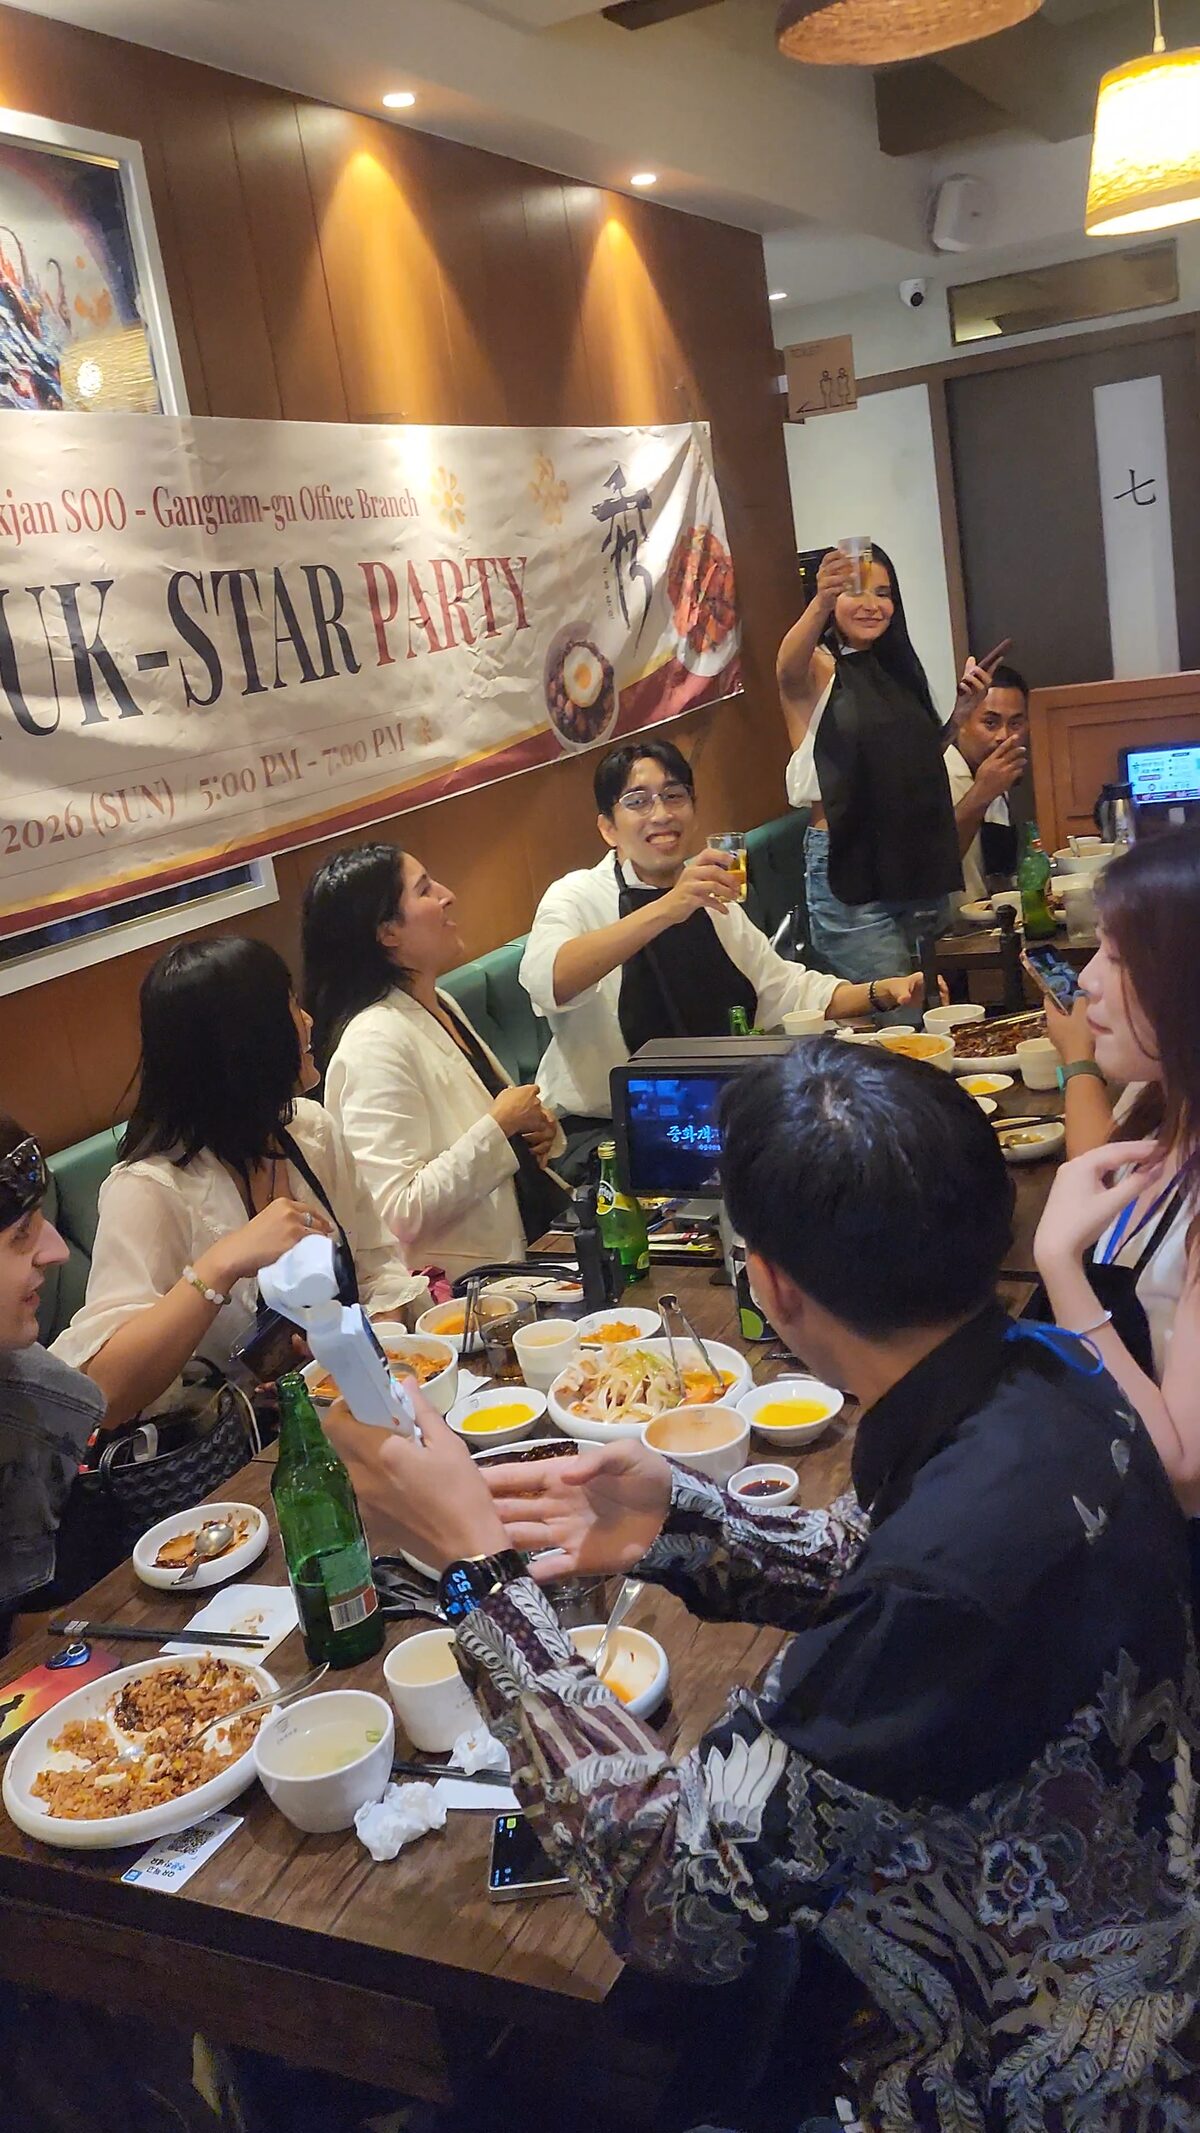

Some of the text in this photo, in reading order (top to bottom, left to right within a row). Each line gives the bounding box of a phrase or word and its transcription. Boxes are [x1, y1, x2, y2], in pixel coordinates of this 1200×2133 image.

[61, 487, 127, 533] SOO
[152, 486, 298, 535] Gangnam-gu
[300, 484, 355, 521] Office
[356, 488, 419, 519] Branch
[1112, 469, 1156, 505] 七
[0, 556, 531, 737] UK-STAR PARTY
[2, 800, 83, 855] 2026
[90, 777, 175, 838] (SUN)
[199, 768, 257, 811] 5:00
[260, 748, 302, 788] PM
[321, 739, 367, 776] 7:00
[371, 723, 406, 759] PM
